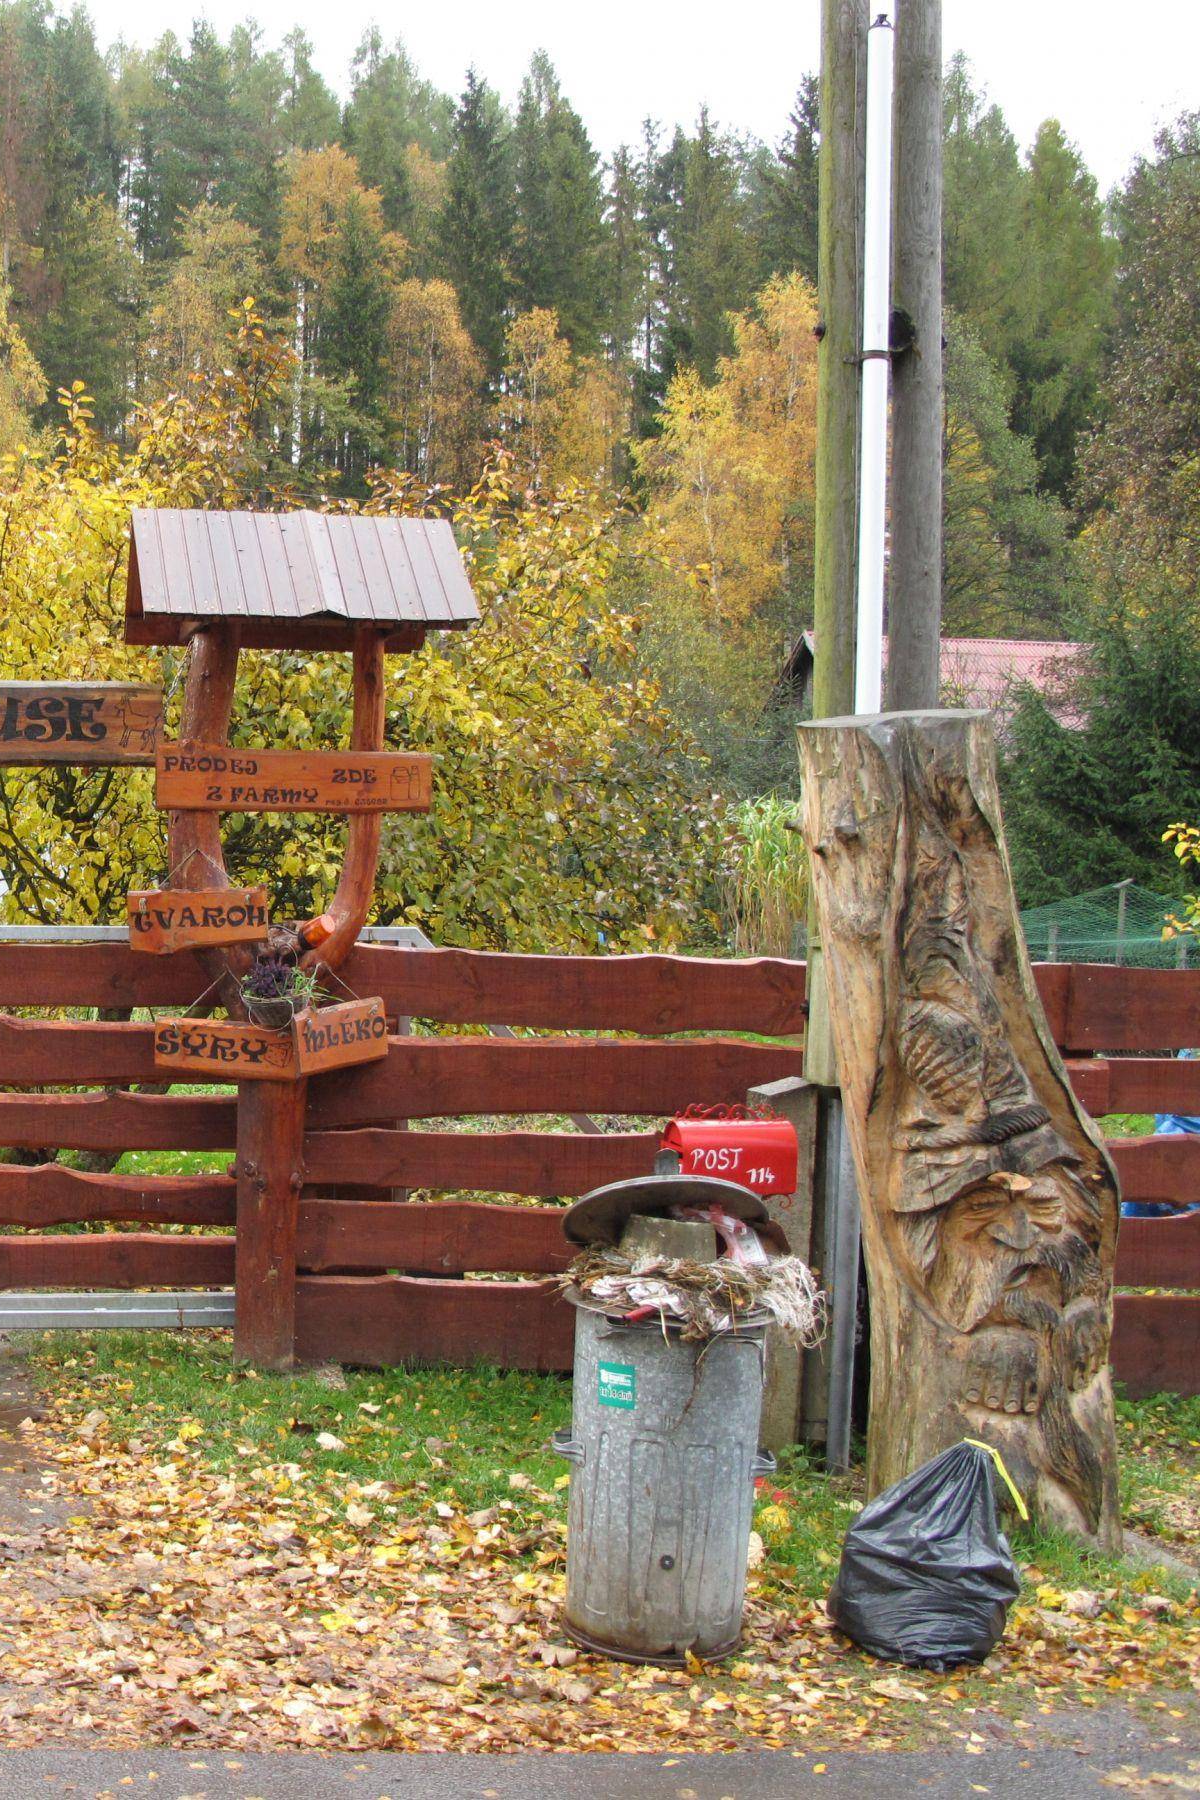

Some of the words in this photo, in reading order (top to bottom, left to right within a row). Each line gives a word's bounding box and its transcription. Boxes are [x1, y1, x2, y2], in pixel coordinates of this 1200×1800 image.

[164, 755, 258, 776] PRODEJ
[331, 768, 378, 784] ZDE
[206, 785, 222, 802] Z
[229, 785, 319, 806] FARMY
[130, 904, 267, 932] TVAROH
[303, 1014, 386, 1053] MLÉKO
[155, 1025, 268, 1065] SÝRY
[690, 1148, 743, 1170] POST
[746, 1167, 775, 1184] 114
